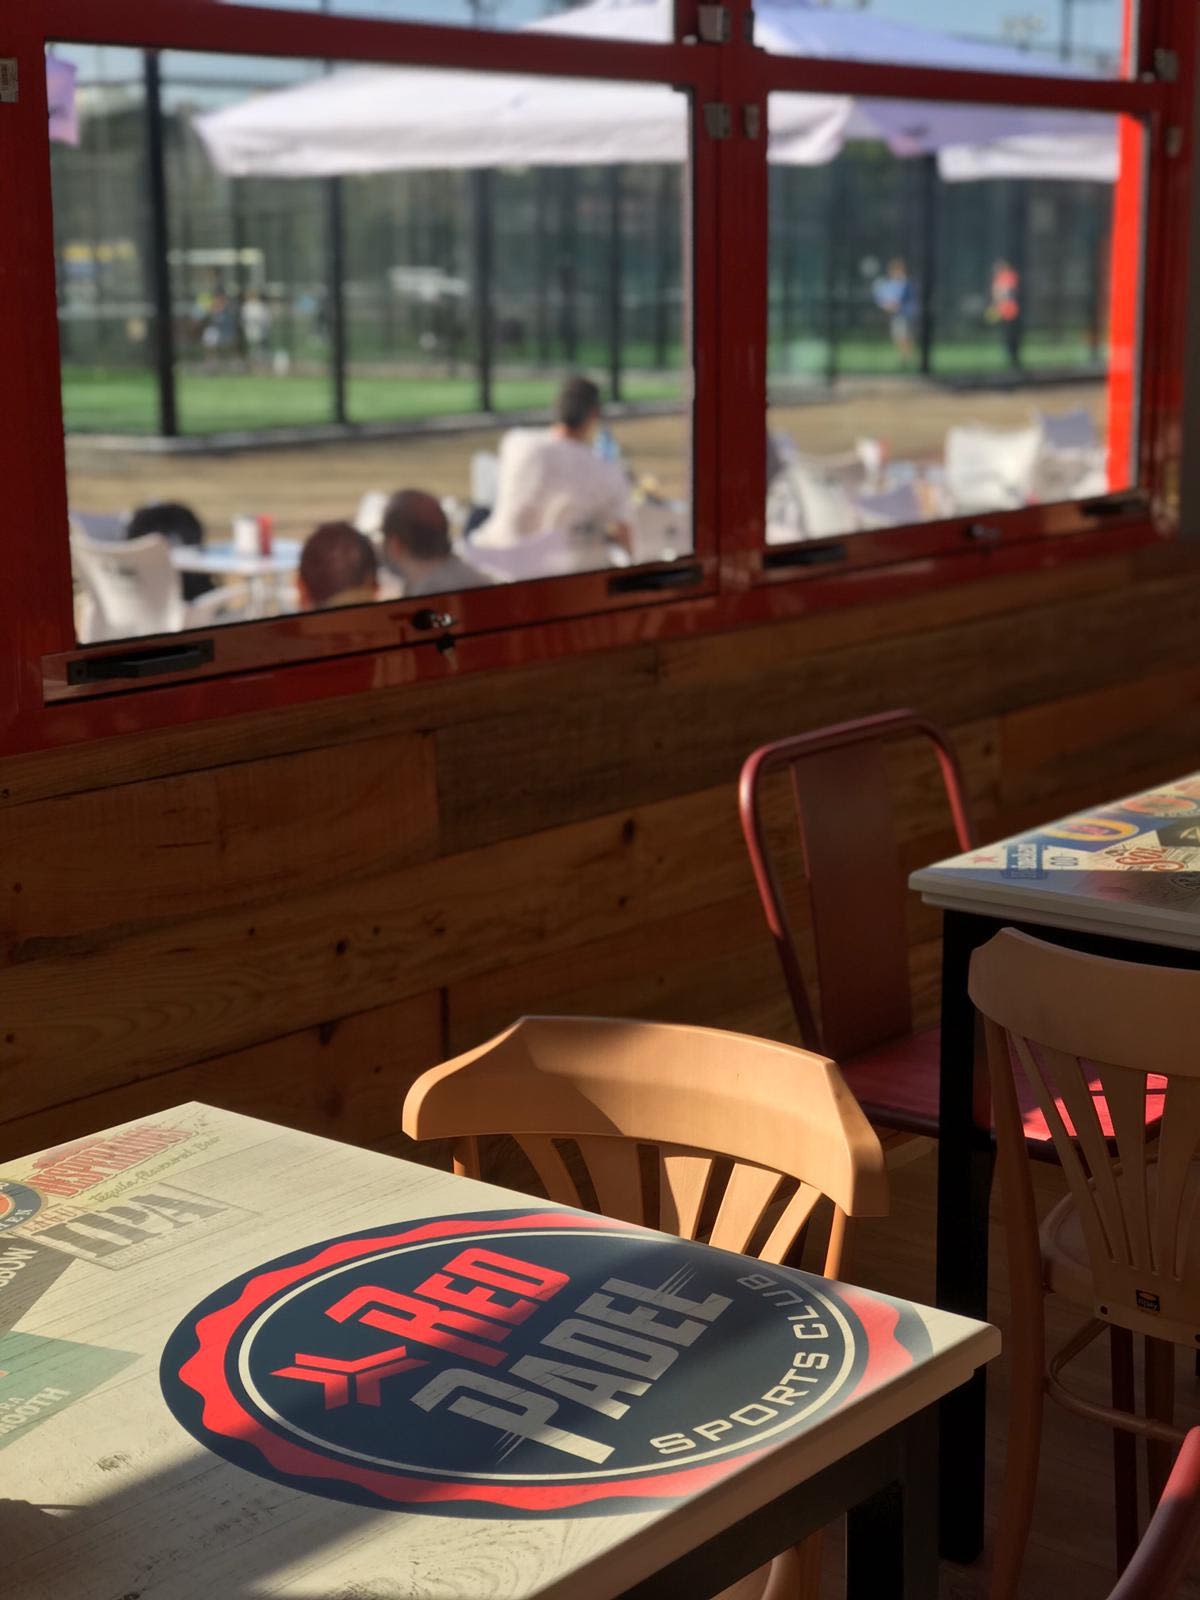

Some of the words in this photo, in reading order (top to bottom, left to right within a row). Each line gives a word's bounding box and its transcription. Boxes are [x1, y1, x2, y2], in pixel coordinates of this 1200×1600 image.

[31, 1194, 229, 1259] IPA
[324, 1247, 570, 1366] RED
[737, 1273, 828, 1339] CLUB
[411, 1277, 734, 1463] PADEL
[649, 1351, 827, 1455] SPORTS
